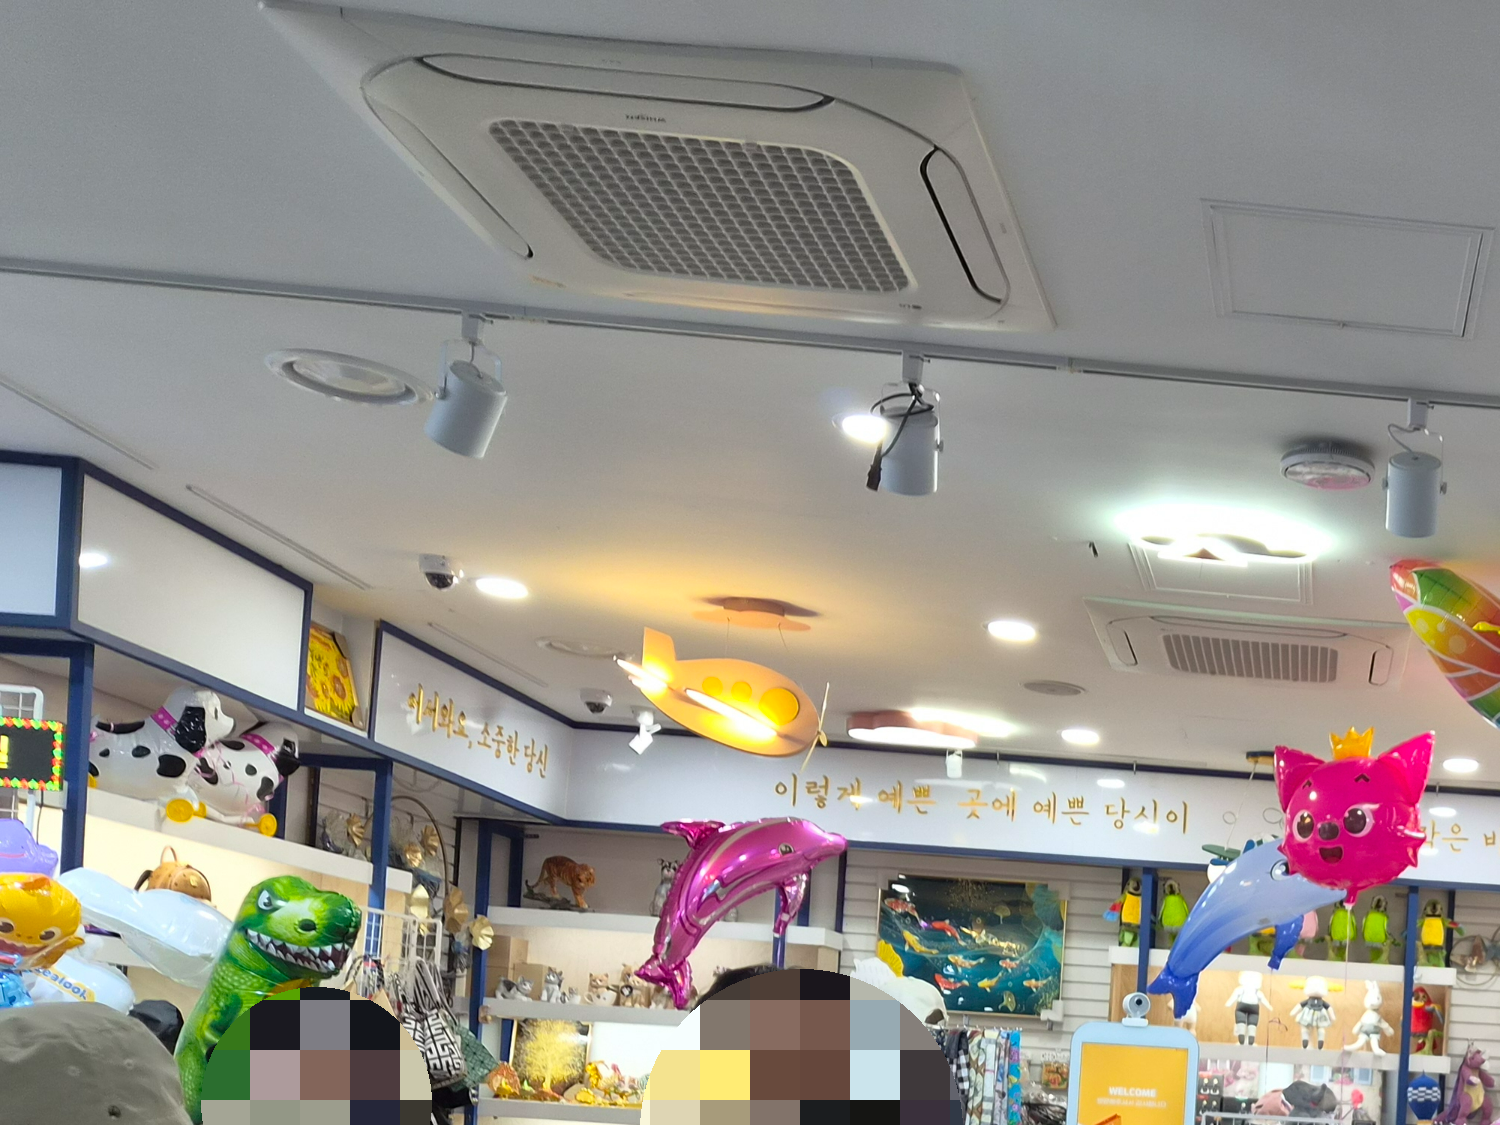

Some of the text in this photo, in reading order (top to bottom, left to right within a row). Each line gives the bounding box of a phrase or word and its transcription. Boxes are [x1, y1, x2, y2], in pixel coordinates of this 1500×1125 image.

[408, 683, 548, 779] 어서와요, 소중한 당신
[775, 772, 862, 811] 이렇게
[877, 779, 936, 815] 예쁜
[957, 788, 1017, 823] 곳에
[1033, 791, 1089, 826] 예쁜
[1108, 1086, 1158, 1098] WELCOME
